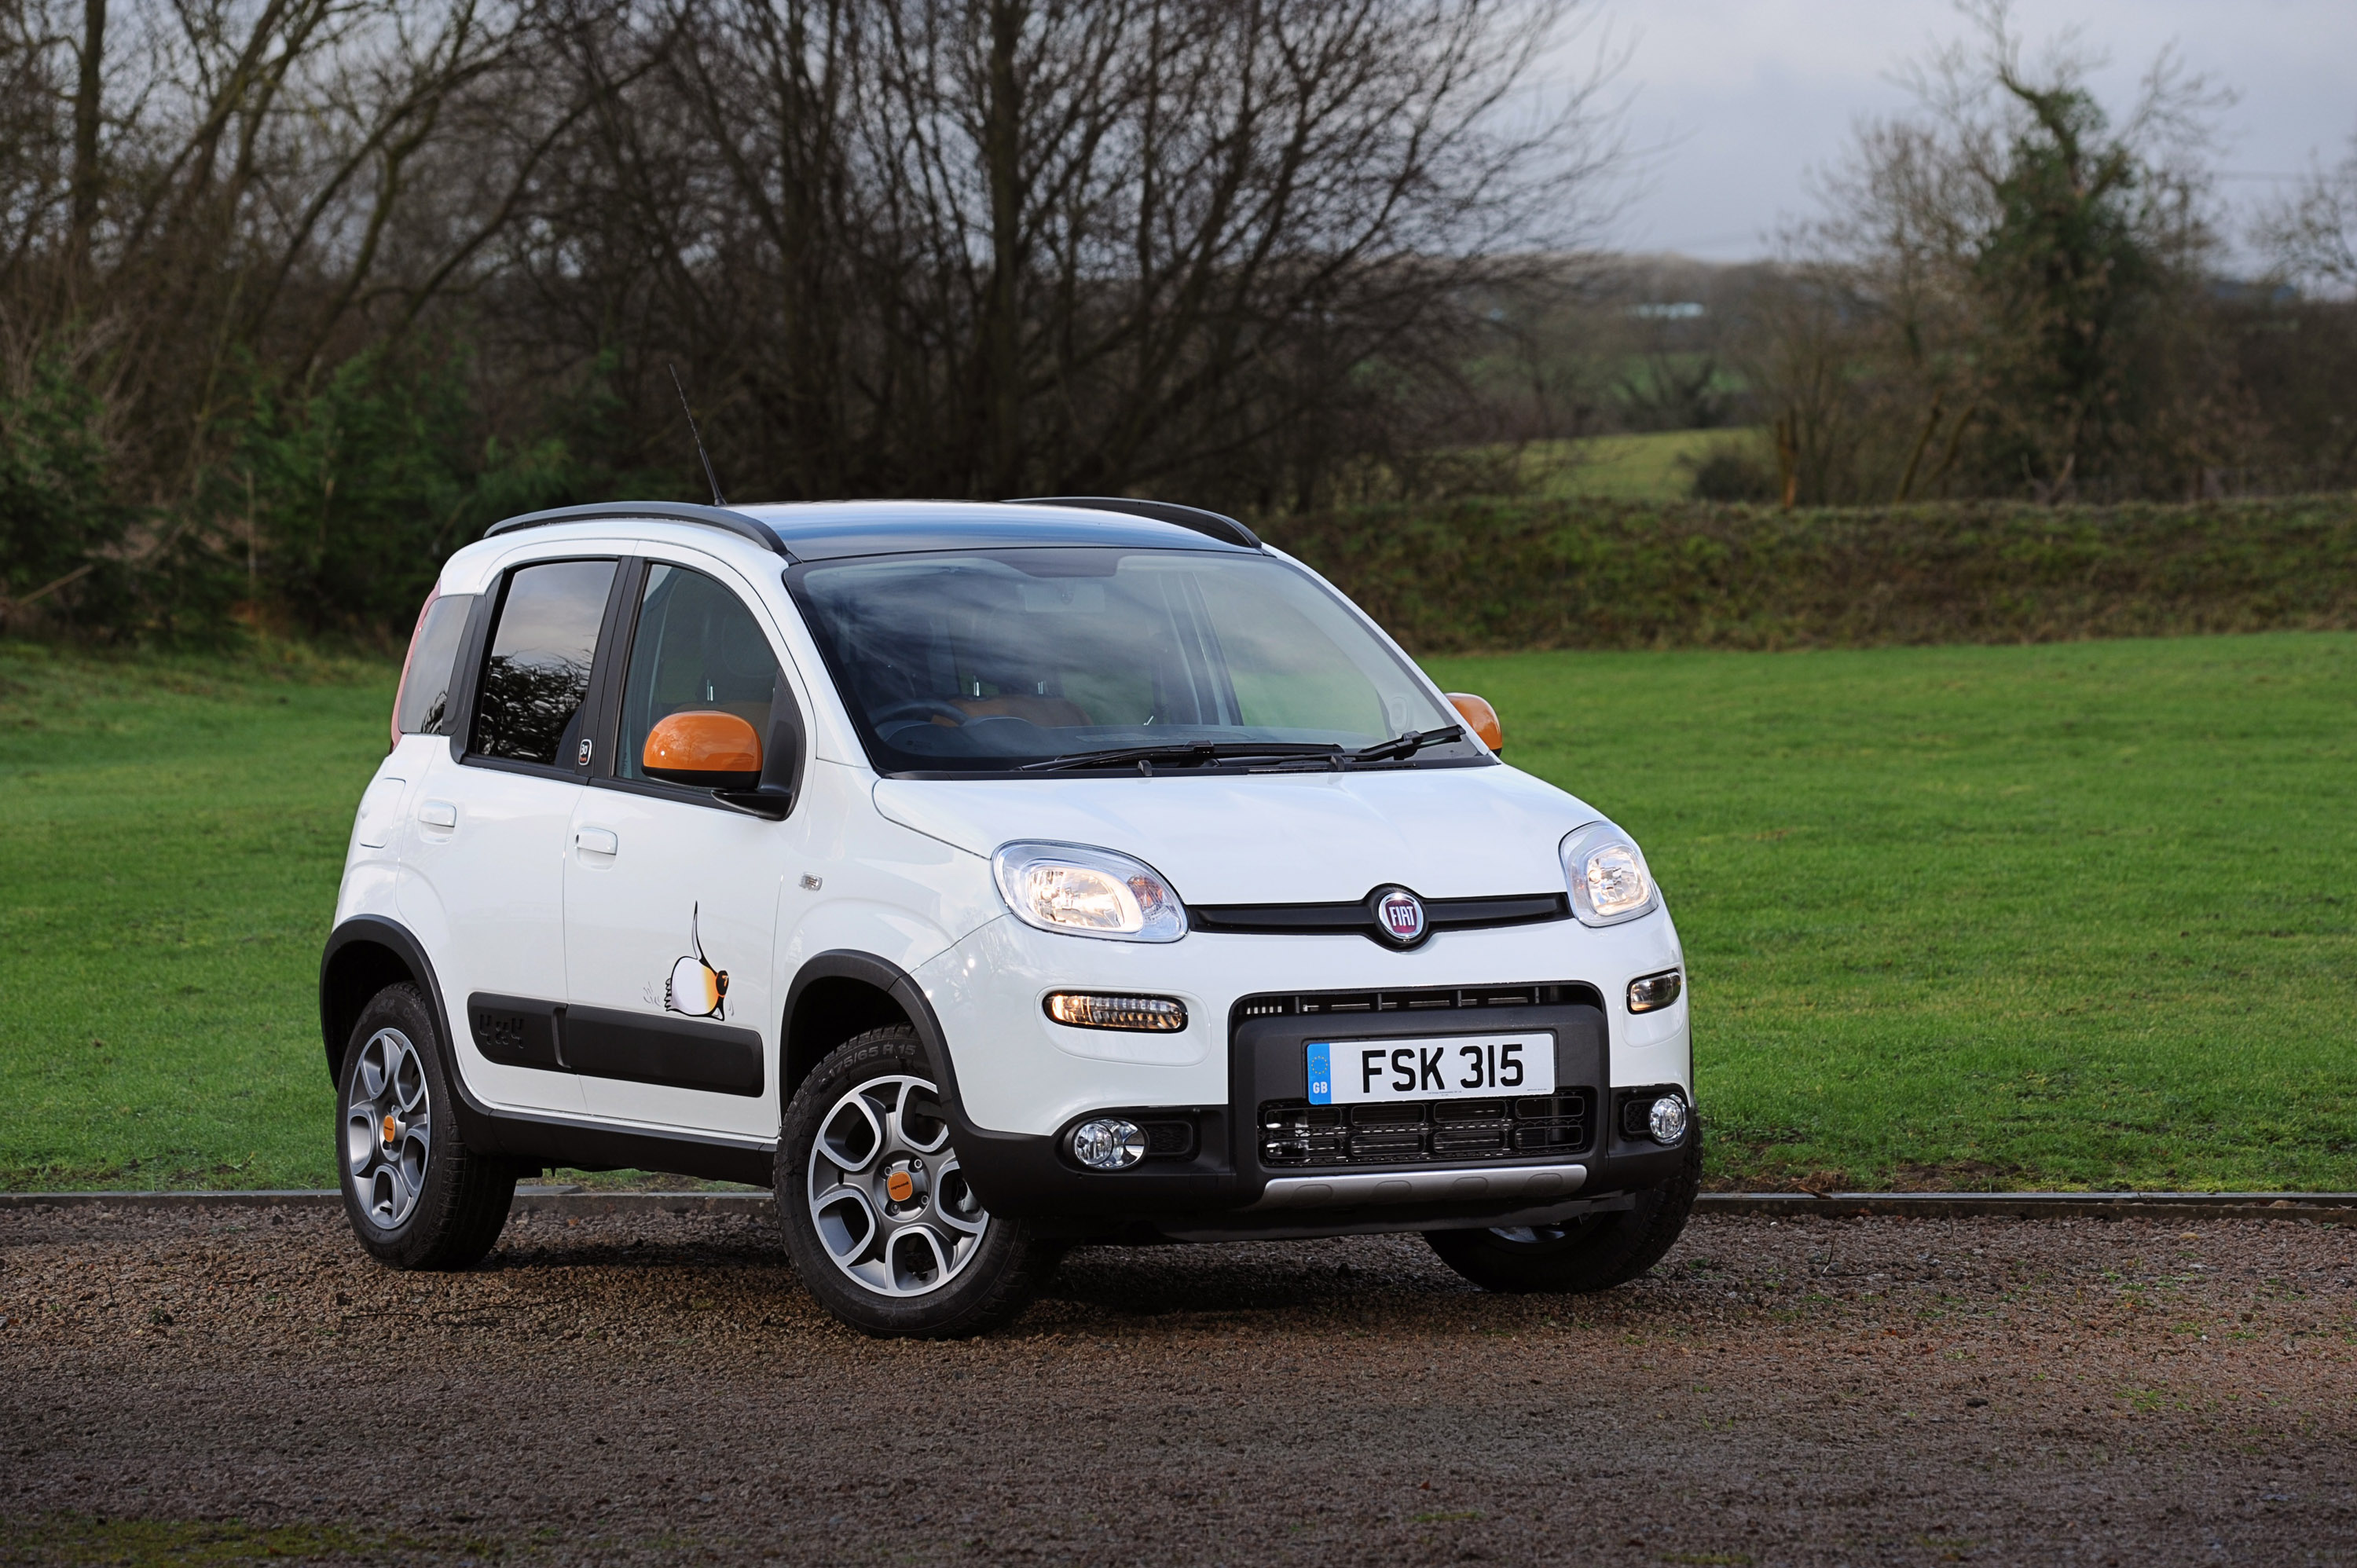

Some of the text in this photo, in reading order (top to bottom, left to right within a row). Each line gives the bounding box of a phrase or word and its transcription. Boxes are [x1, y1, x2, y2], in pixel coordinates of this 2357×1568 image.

[1388, 906, 1415, 926] FIAT
[829, 1043, 917, 1078] 175/65 R 15
[1362, 1043, 1523, 1094] FSK 315
[1312, 1081, 1329, 1094] GB
